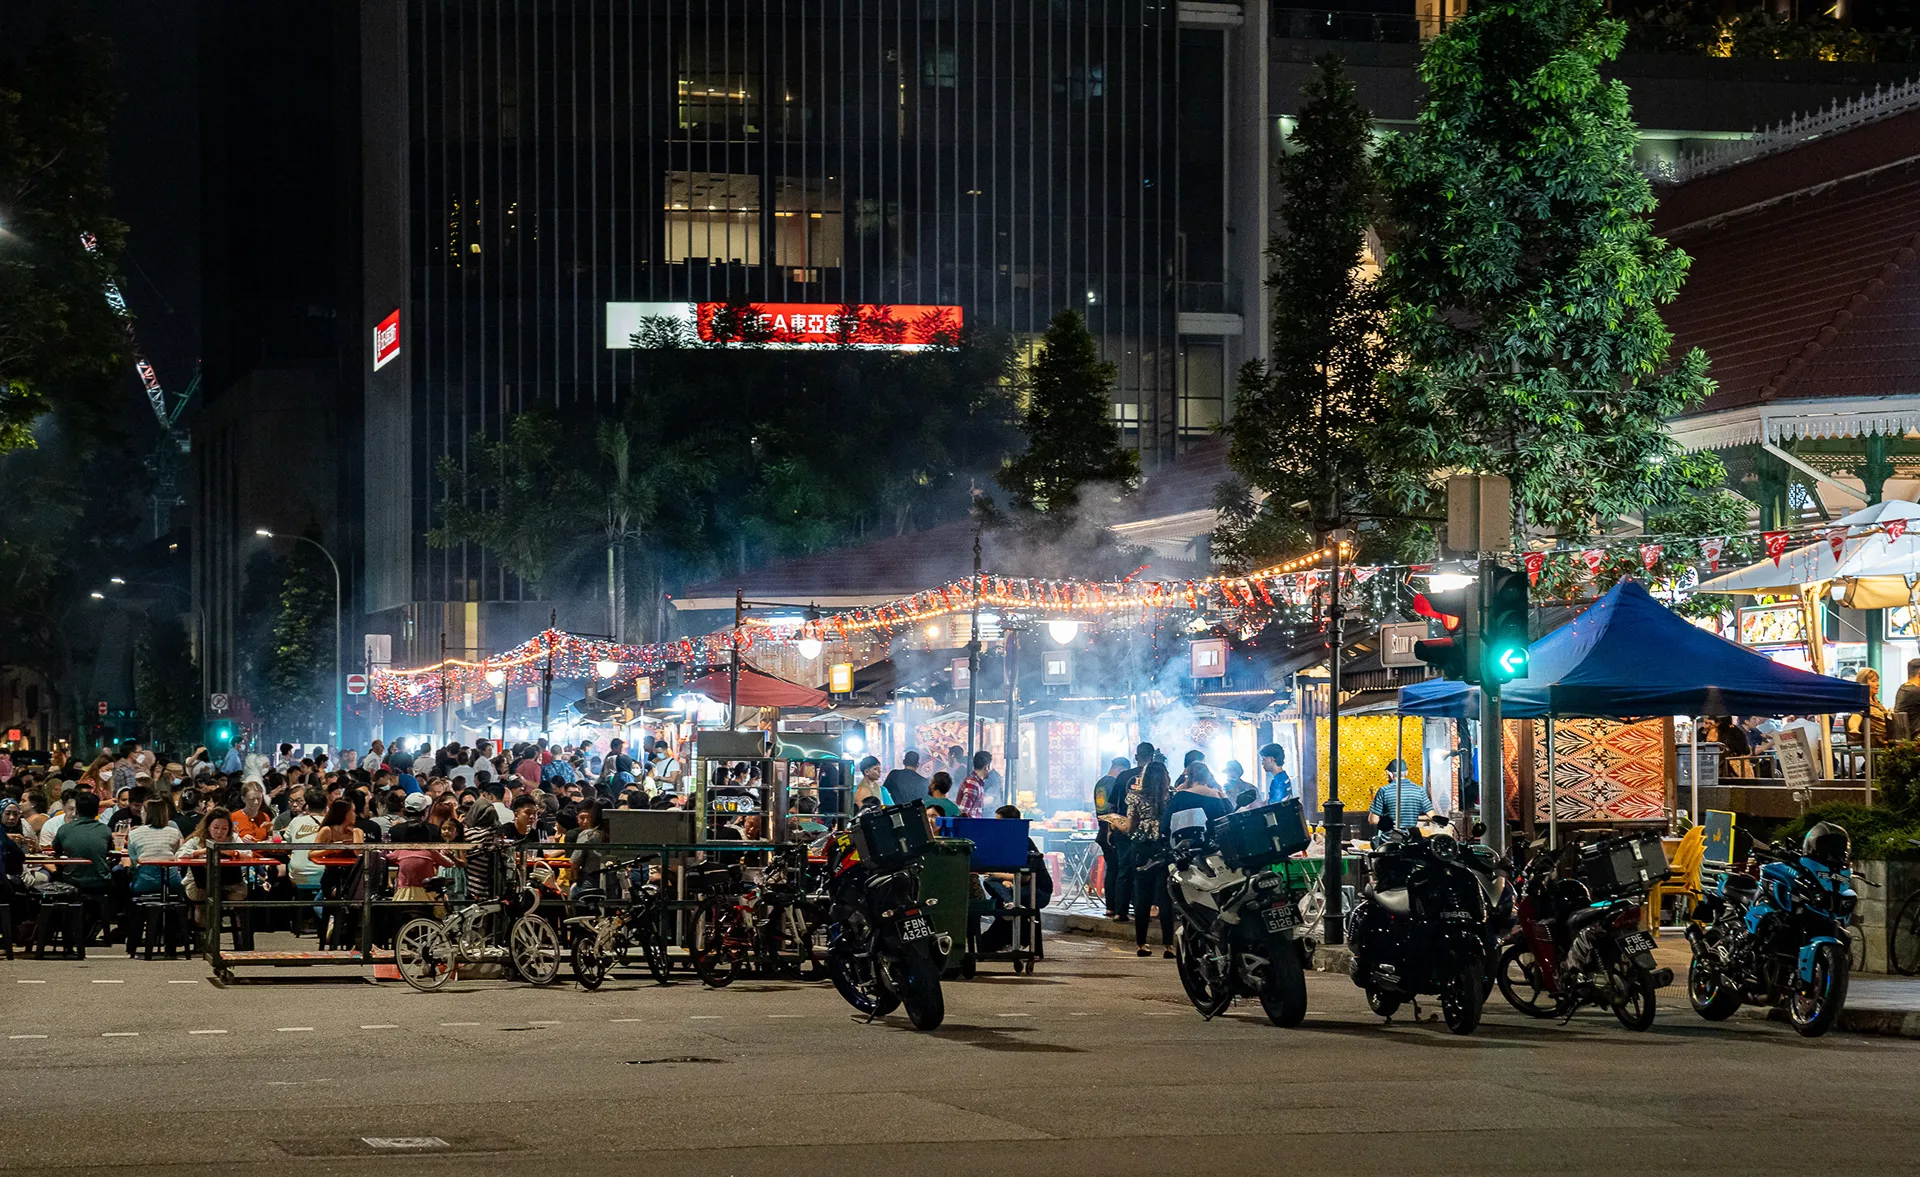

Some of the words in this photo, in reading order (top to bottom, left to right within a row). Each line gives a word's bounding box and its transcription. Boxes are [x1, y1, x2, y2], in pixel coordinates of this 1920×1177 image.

[299, 823, 319, 833] NIKE
[904, 917, 926, 931] FBN
[903, 925, 936, 941] 4326L
[1624, 933, 1645, 946] FBE
[1624, 940, 1654, 955] 1646E
